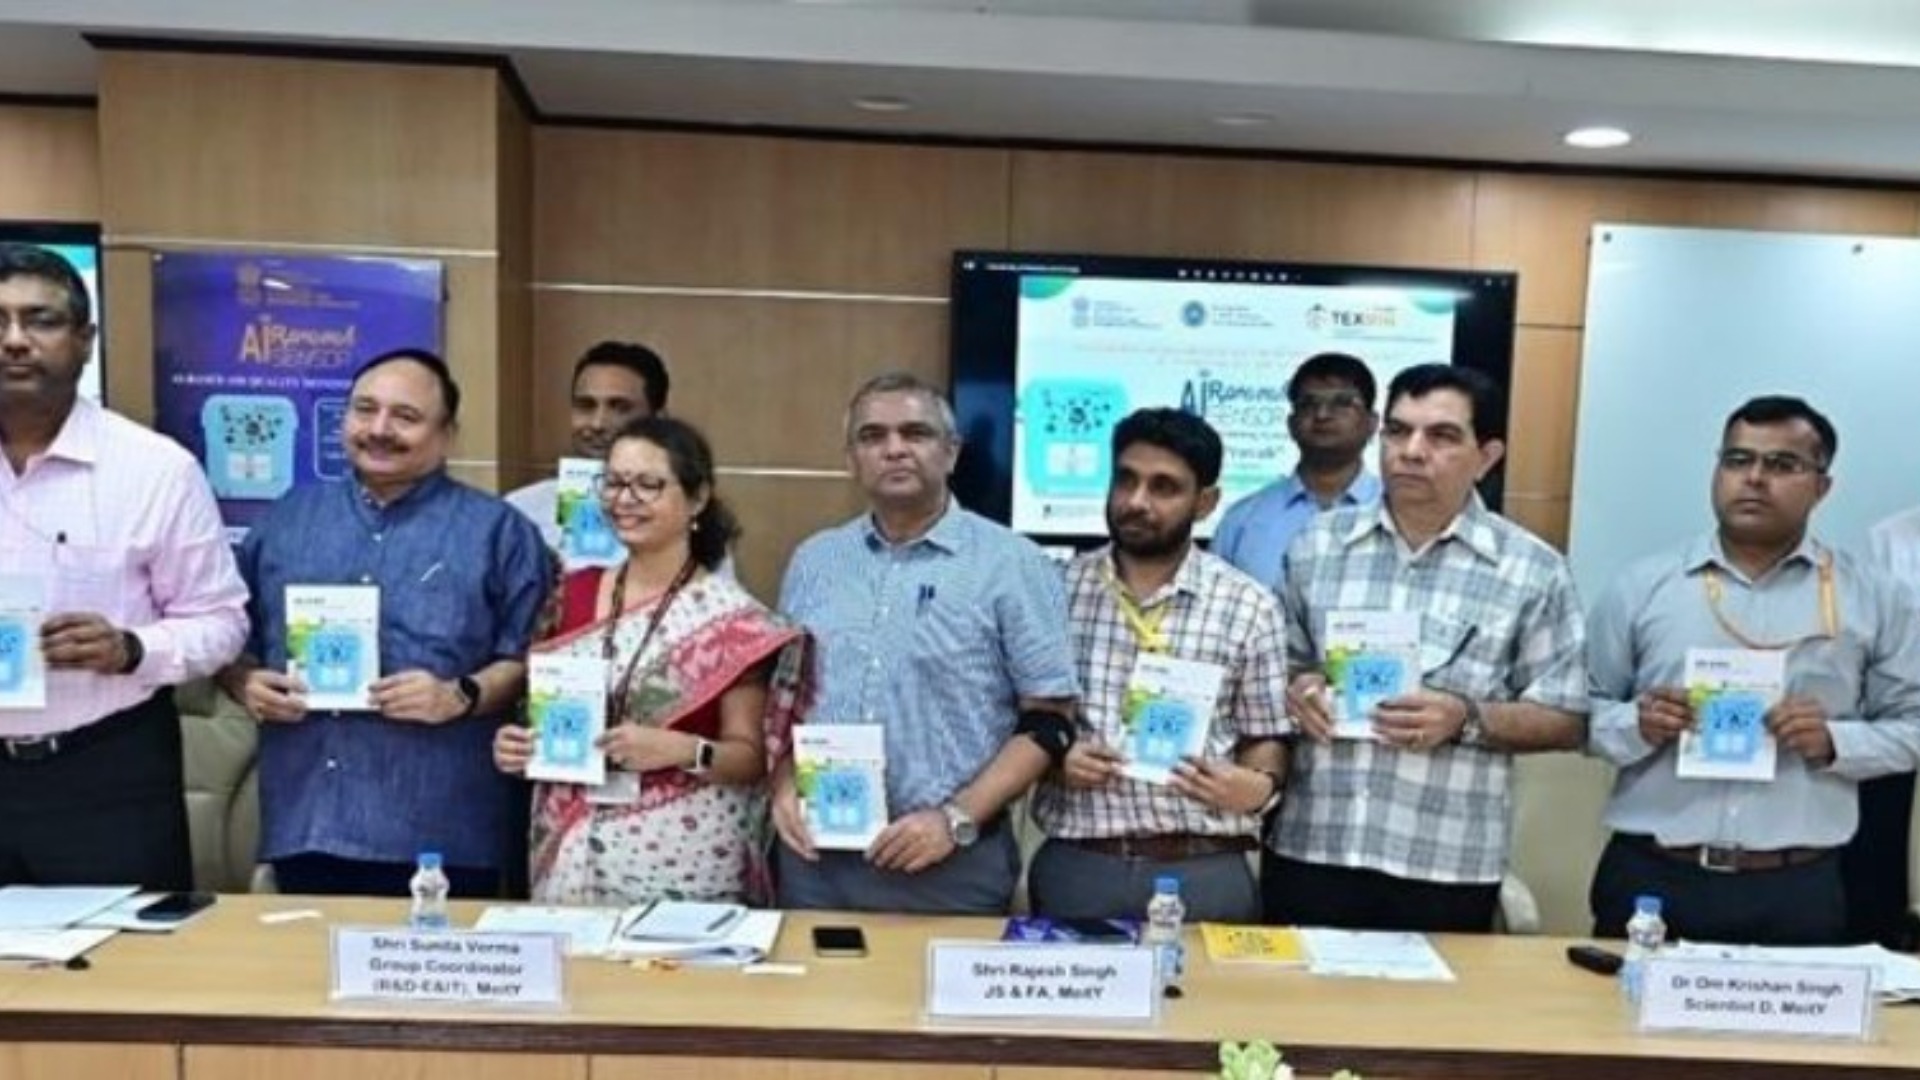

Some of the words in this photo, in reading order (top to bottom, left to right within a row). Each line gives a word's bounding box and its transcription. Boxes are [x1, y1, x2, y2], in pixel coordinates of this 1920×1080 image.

[372, 937, 406, 950] Shri
[466, 940, 520, 954] Verma
[370, 957, 422, 974] Group
[425, 960, 523, 975] Coordinator
[973, 962, 1006, 977] Shri
[1010, 962, 1066, 981] Rajesh
[1070, 963, 1118, 981] Singh
[984, 985, 1005, 1000] JS
[1010, 985, 1022, 1000] &
[1671, 975, 1691, 989] Dr
[1695, 975, 1724, 989] Om
[1728, 978, 1792, 992] Krishan
[1796, 980, 1843, 999] Singh
[1684, 998, 1754, 1012] Scientist
